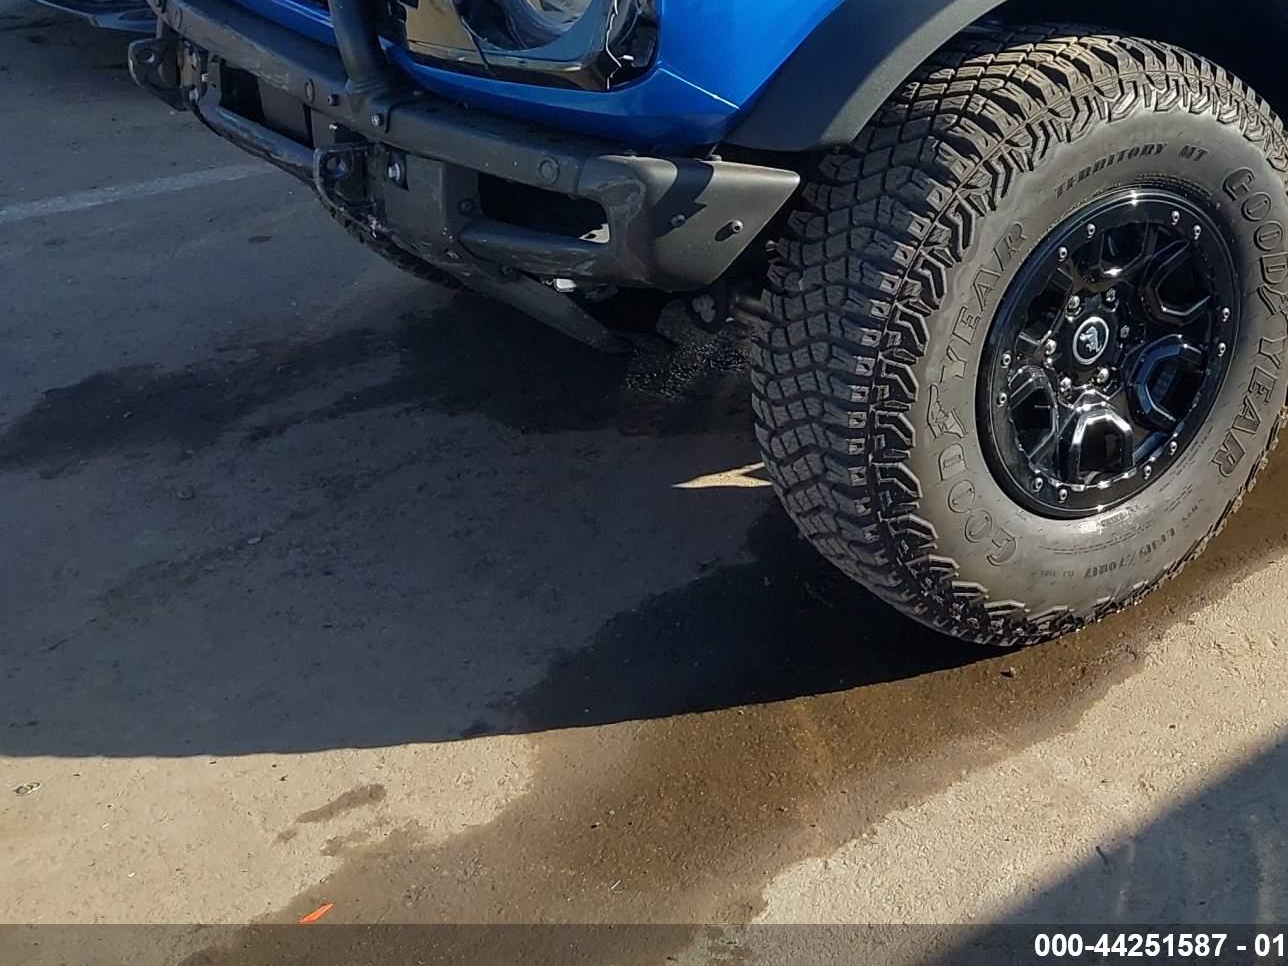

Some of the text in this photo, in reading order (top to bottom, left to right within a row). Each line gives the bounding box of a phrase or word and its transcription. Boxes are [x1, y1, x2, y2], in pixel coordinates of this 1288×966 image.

[1054, 142, 1168, 199] TERRITORY
[1178, 144, 1209, 163] MT
[926, 221, 1026, 567] GOODYEAR
